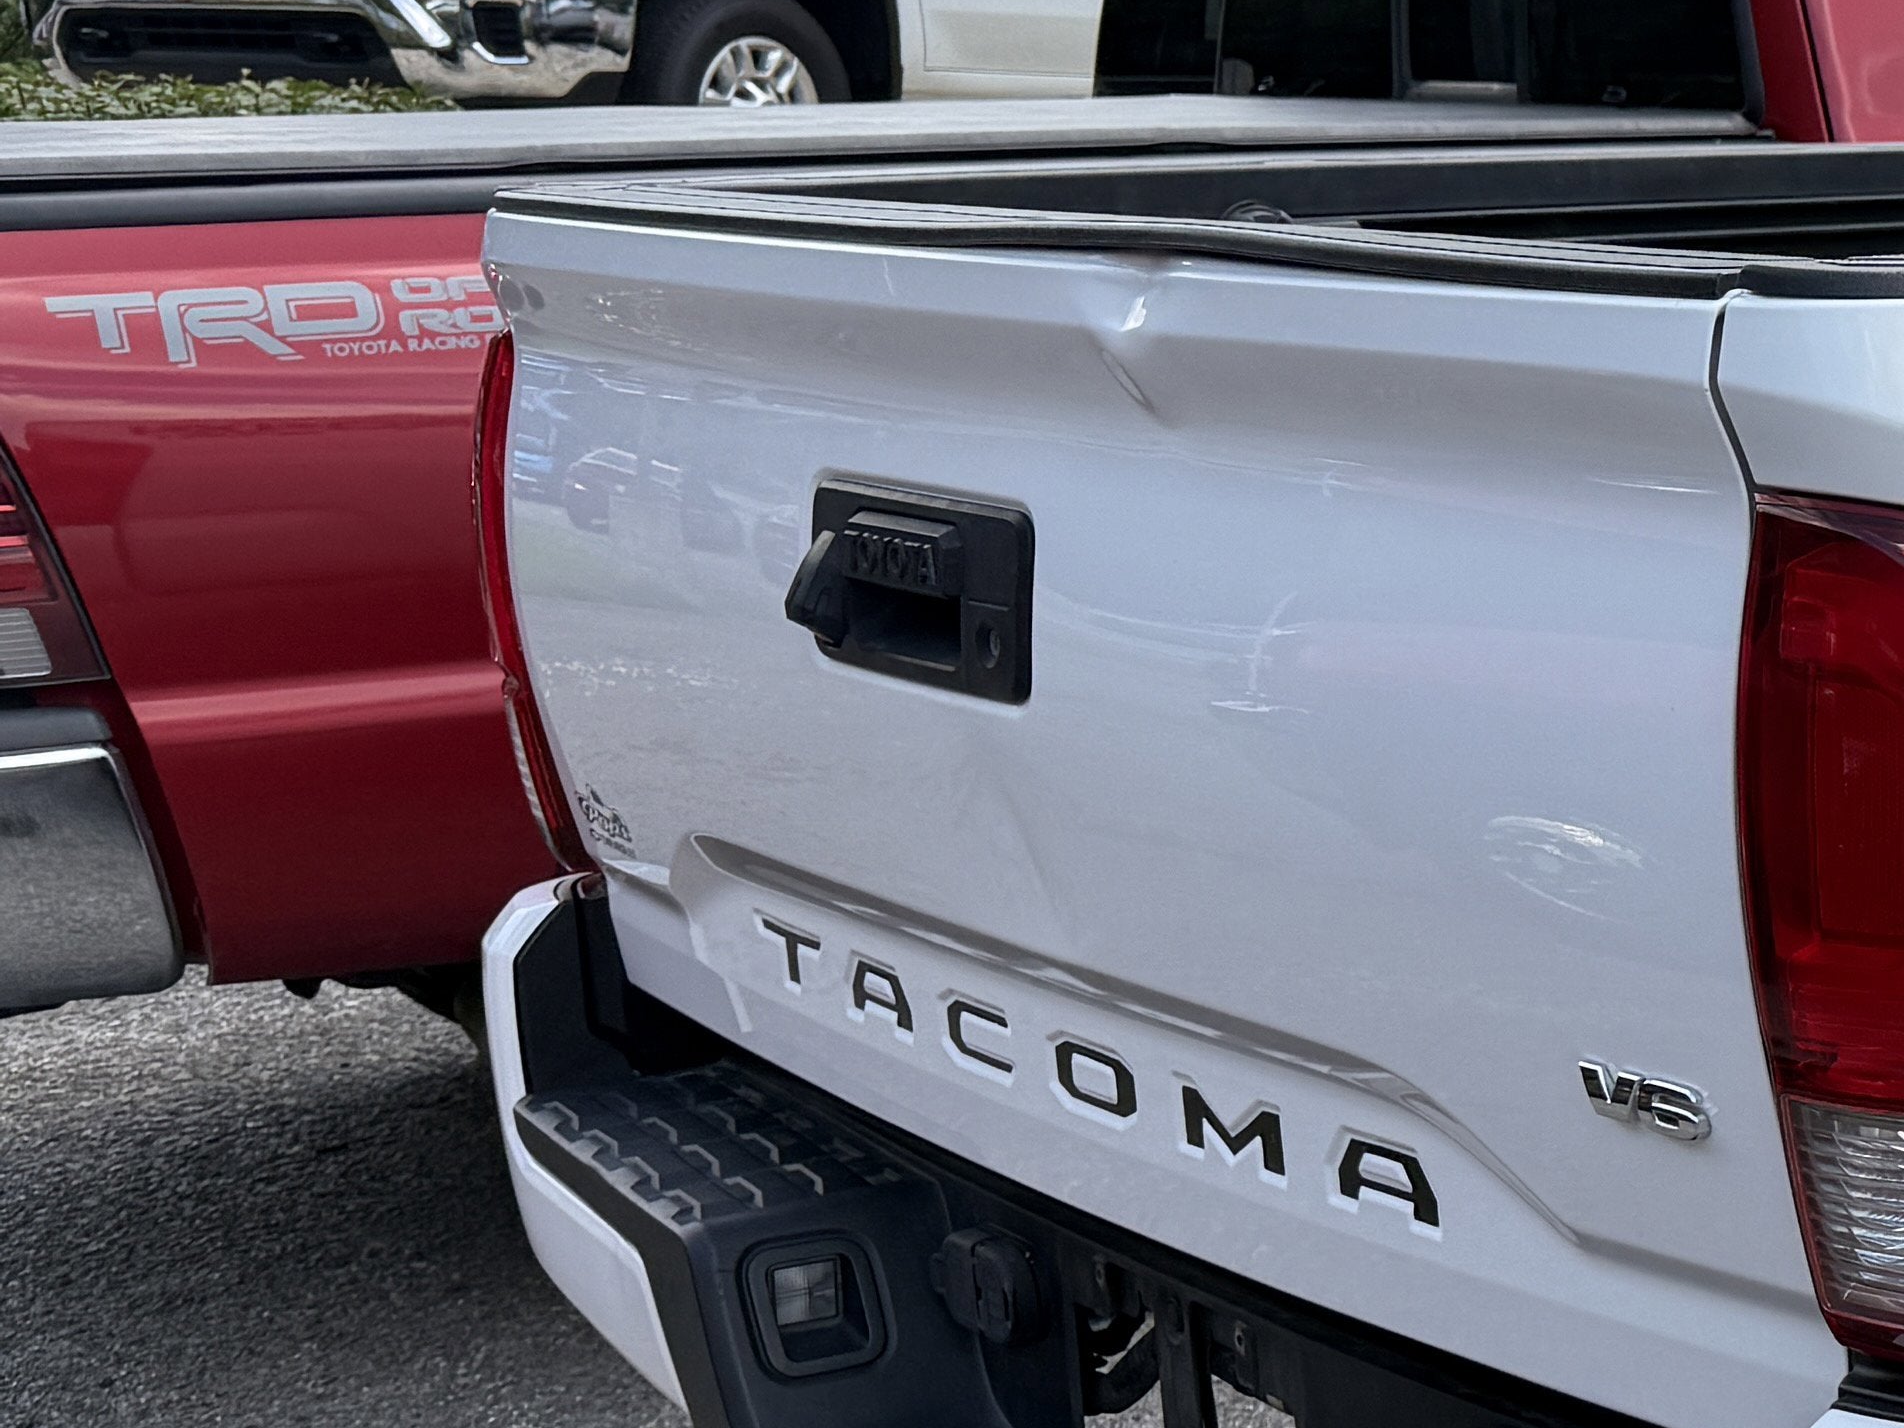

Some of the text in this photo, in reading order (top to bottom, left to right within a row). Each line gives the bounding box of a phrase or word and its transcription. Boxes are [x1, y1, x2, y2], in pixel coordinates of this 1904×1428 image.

[45, 275, 490, 368] TRD OF
[322, 340, 403, 358] TOYOTA
[407, 334, 482, 352] RACING
[399, 305, 505, 336] RO
[754, 912, 1442, 1238] TACOMA
[1577, 1058, 1712, 1140] V6
